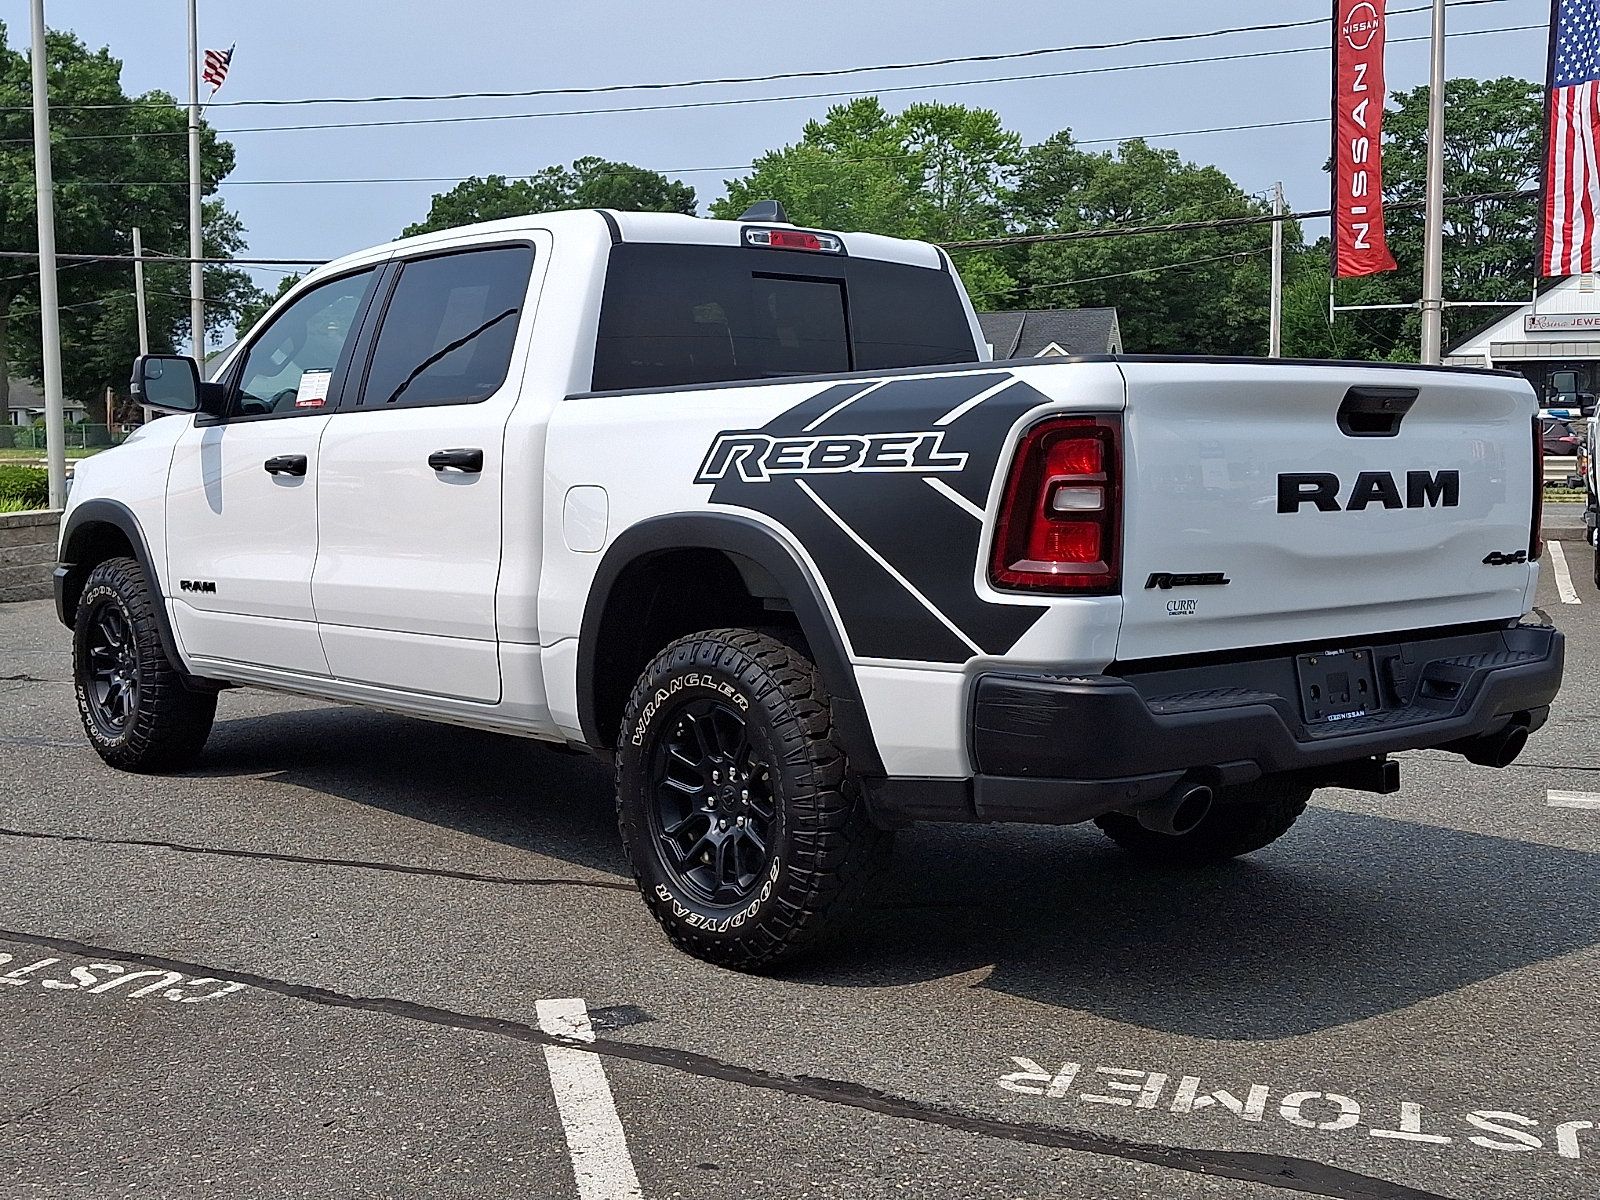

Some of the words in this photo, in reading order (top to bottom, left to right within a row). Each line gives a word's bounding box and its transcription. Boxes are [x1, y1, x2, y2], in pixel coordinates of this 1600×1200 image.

[1343, 19, 1379, 35] NISSAN
[1351, 63, 1371, 250] NISSAN
[698, 431, 970, 483] REBEL
[1277, 470, 1460, 514] RAM
[180, 580, 217, 594] RAM
[1144, 572, 1231, 590] REBEL
[1166, 599, 1199, 612] CURRY
[631, 672, 749, 747] WRANGLER
[655, 856, 780, 933] GOODYEAR
[0, 952, 247, 1003] CUST
